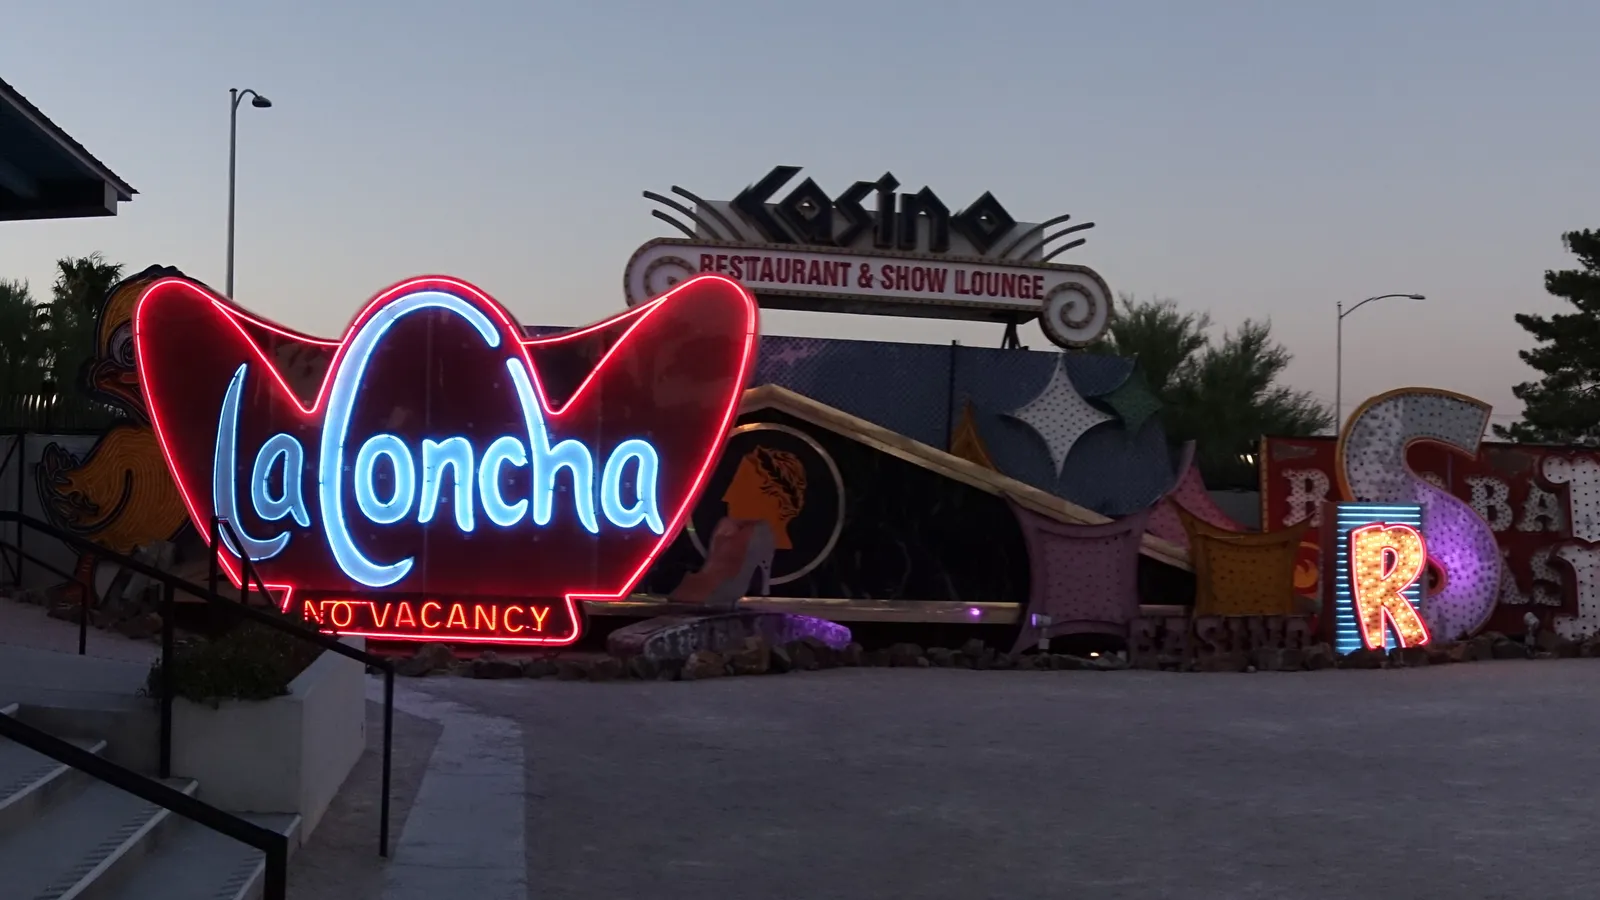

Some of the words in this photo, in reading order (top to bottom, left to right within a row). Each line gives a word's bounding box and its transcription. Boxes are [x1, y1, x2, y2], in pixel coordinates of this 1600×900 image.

[700, 253, 852, 287] RESTAURANT
[857, 262, 873, 289] &
[880, 264, 948, 293] SHOW
[954, 270, 1045, 300] LOUNGE
[213, 362, 311, 562] La
[319, 290, 665, 588] Concha
[303, 600, 353, 628] NO
[369, 601, 551, 633] VACANCY
[1350, 521, 1432, 650] R
